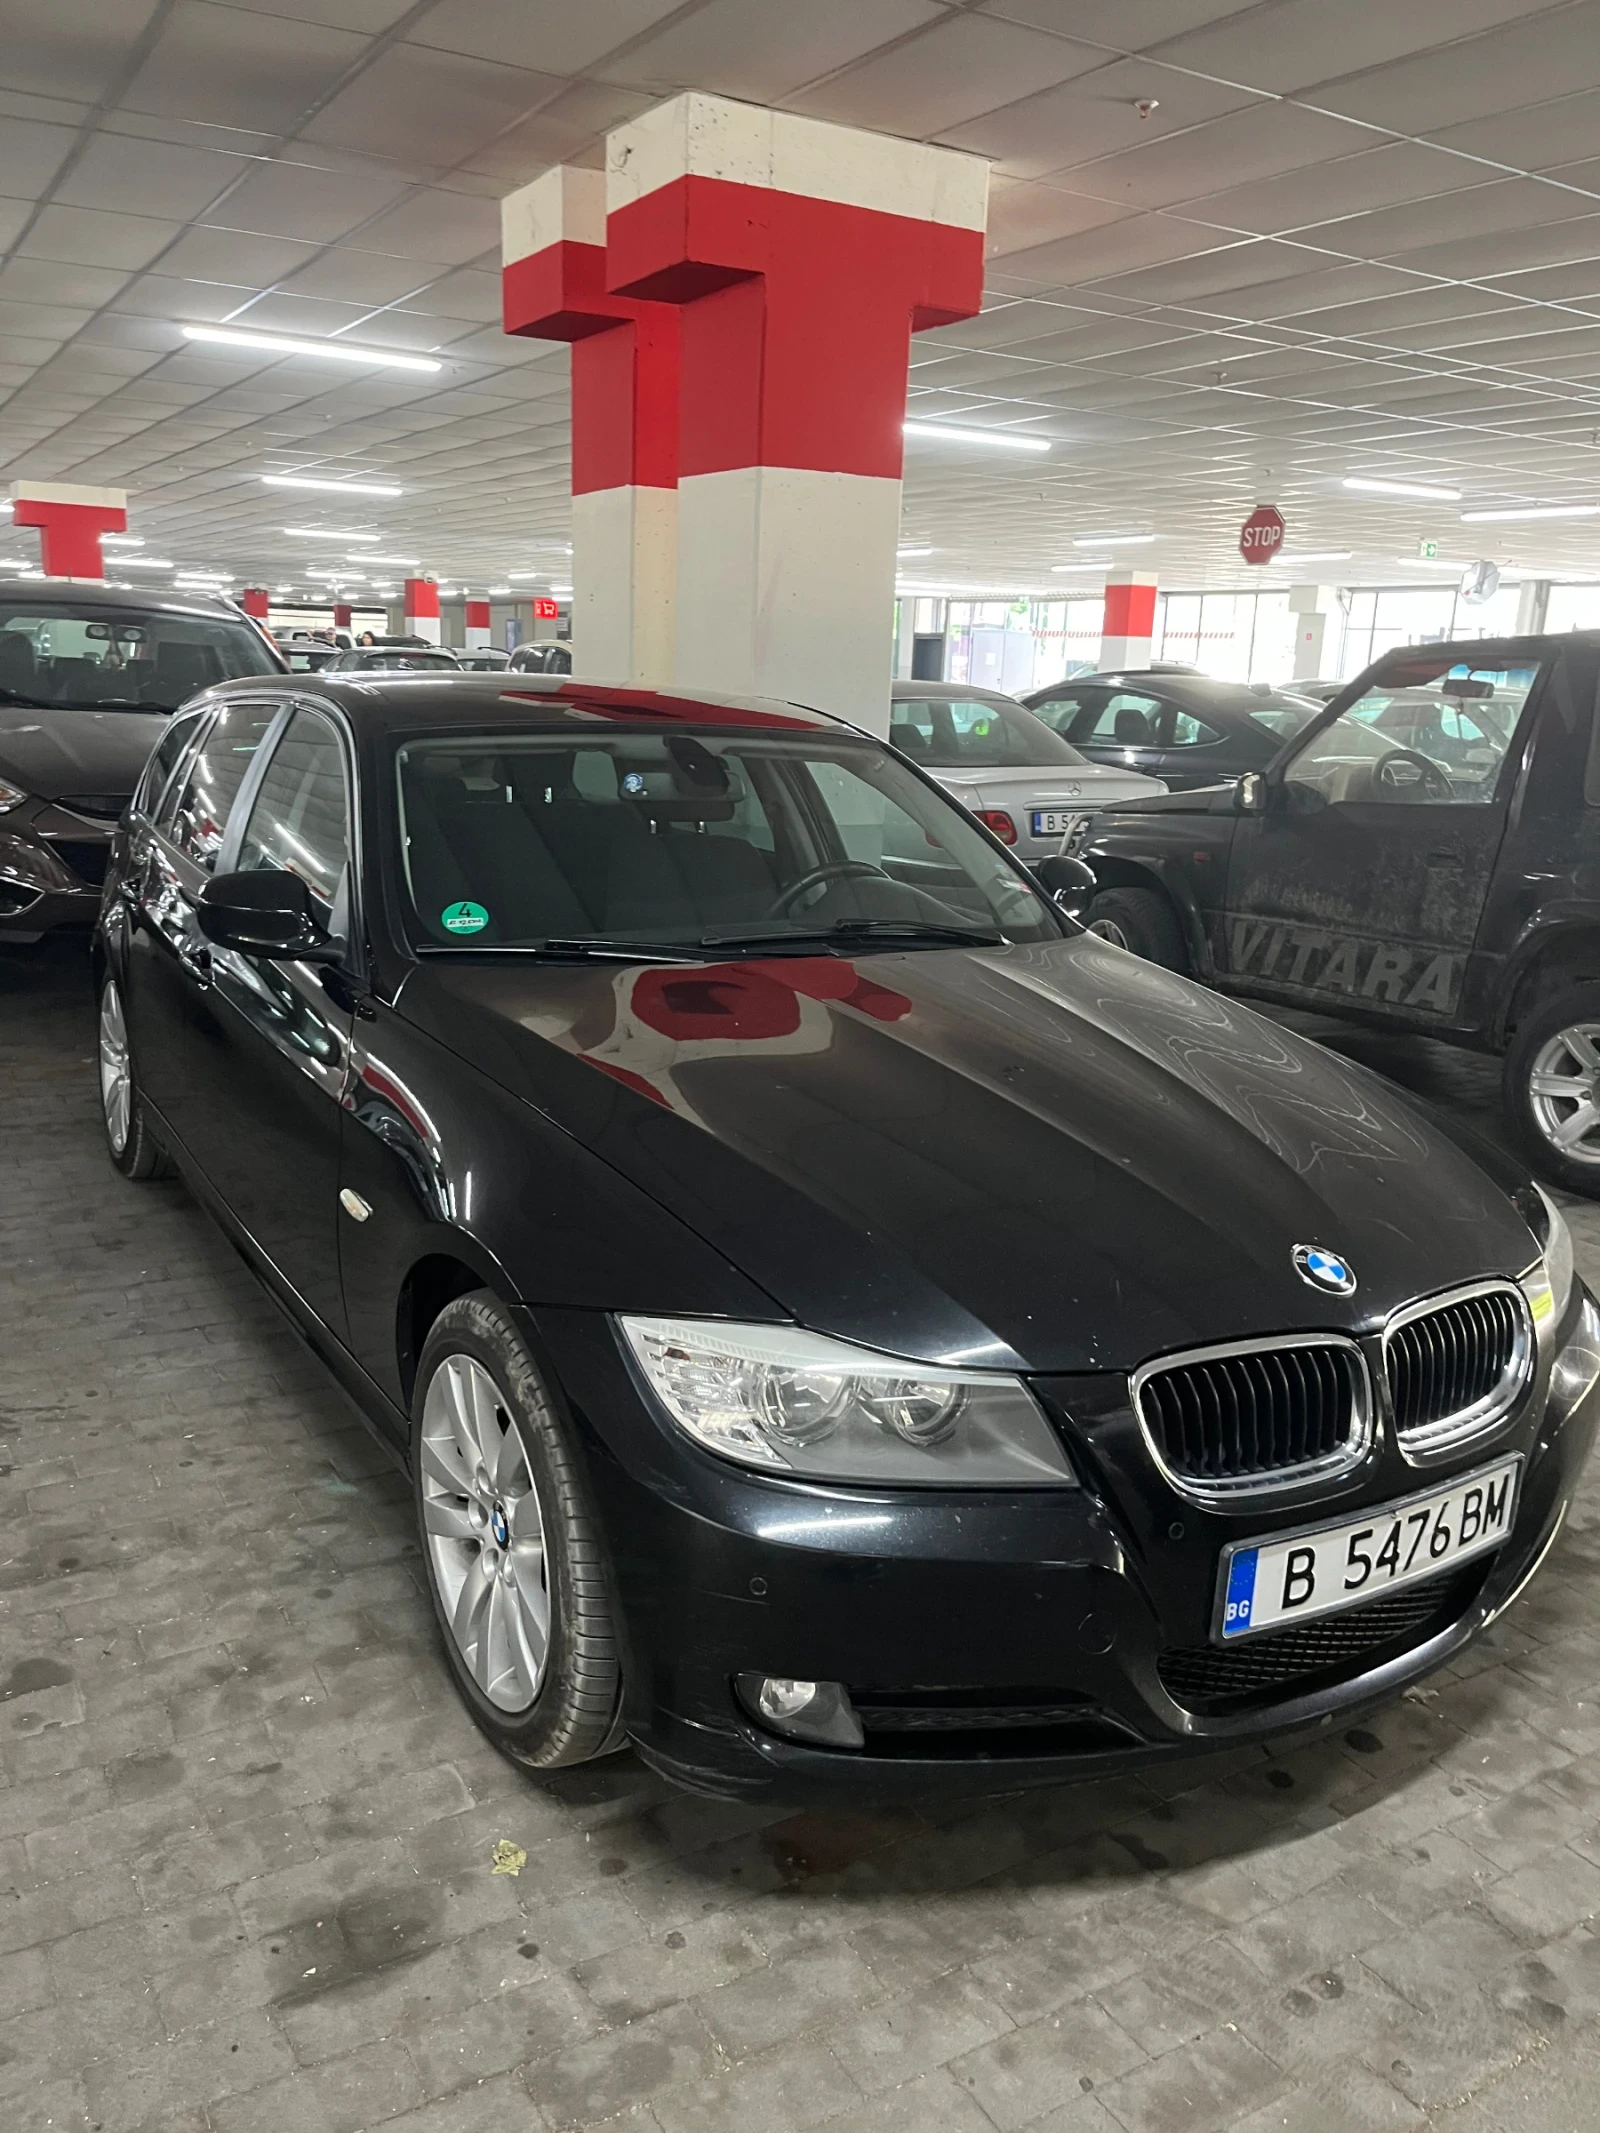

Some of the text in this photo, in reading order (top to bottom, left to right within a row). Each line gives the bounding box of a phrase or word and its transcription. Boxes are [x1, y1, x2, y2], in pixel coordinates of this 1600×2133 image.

[1243, 526, 1281, 547] STOP
[1047, 815, 1056, 831] B
[458, 903, 472, 917] 4
[1230, 921, 1459, 1014] VITARA
[1281, 1473, 1511, 1610] B 5476 BM
[1226, 1599, 1250, 1621] BG
